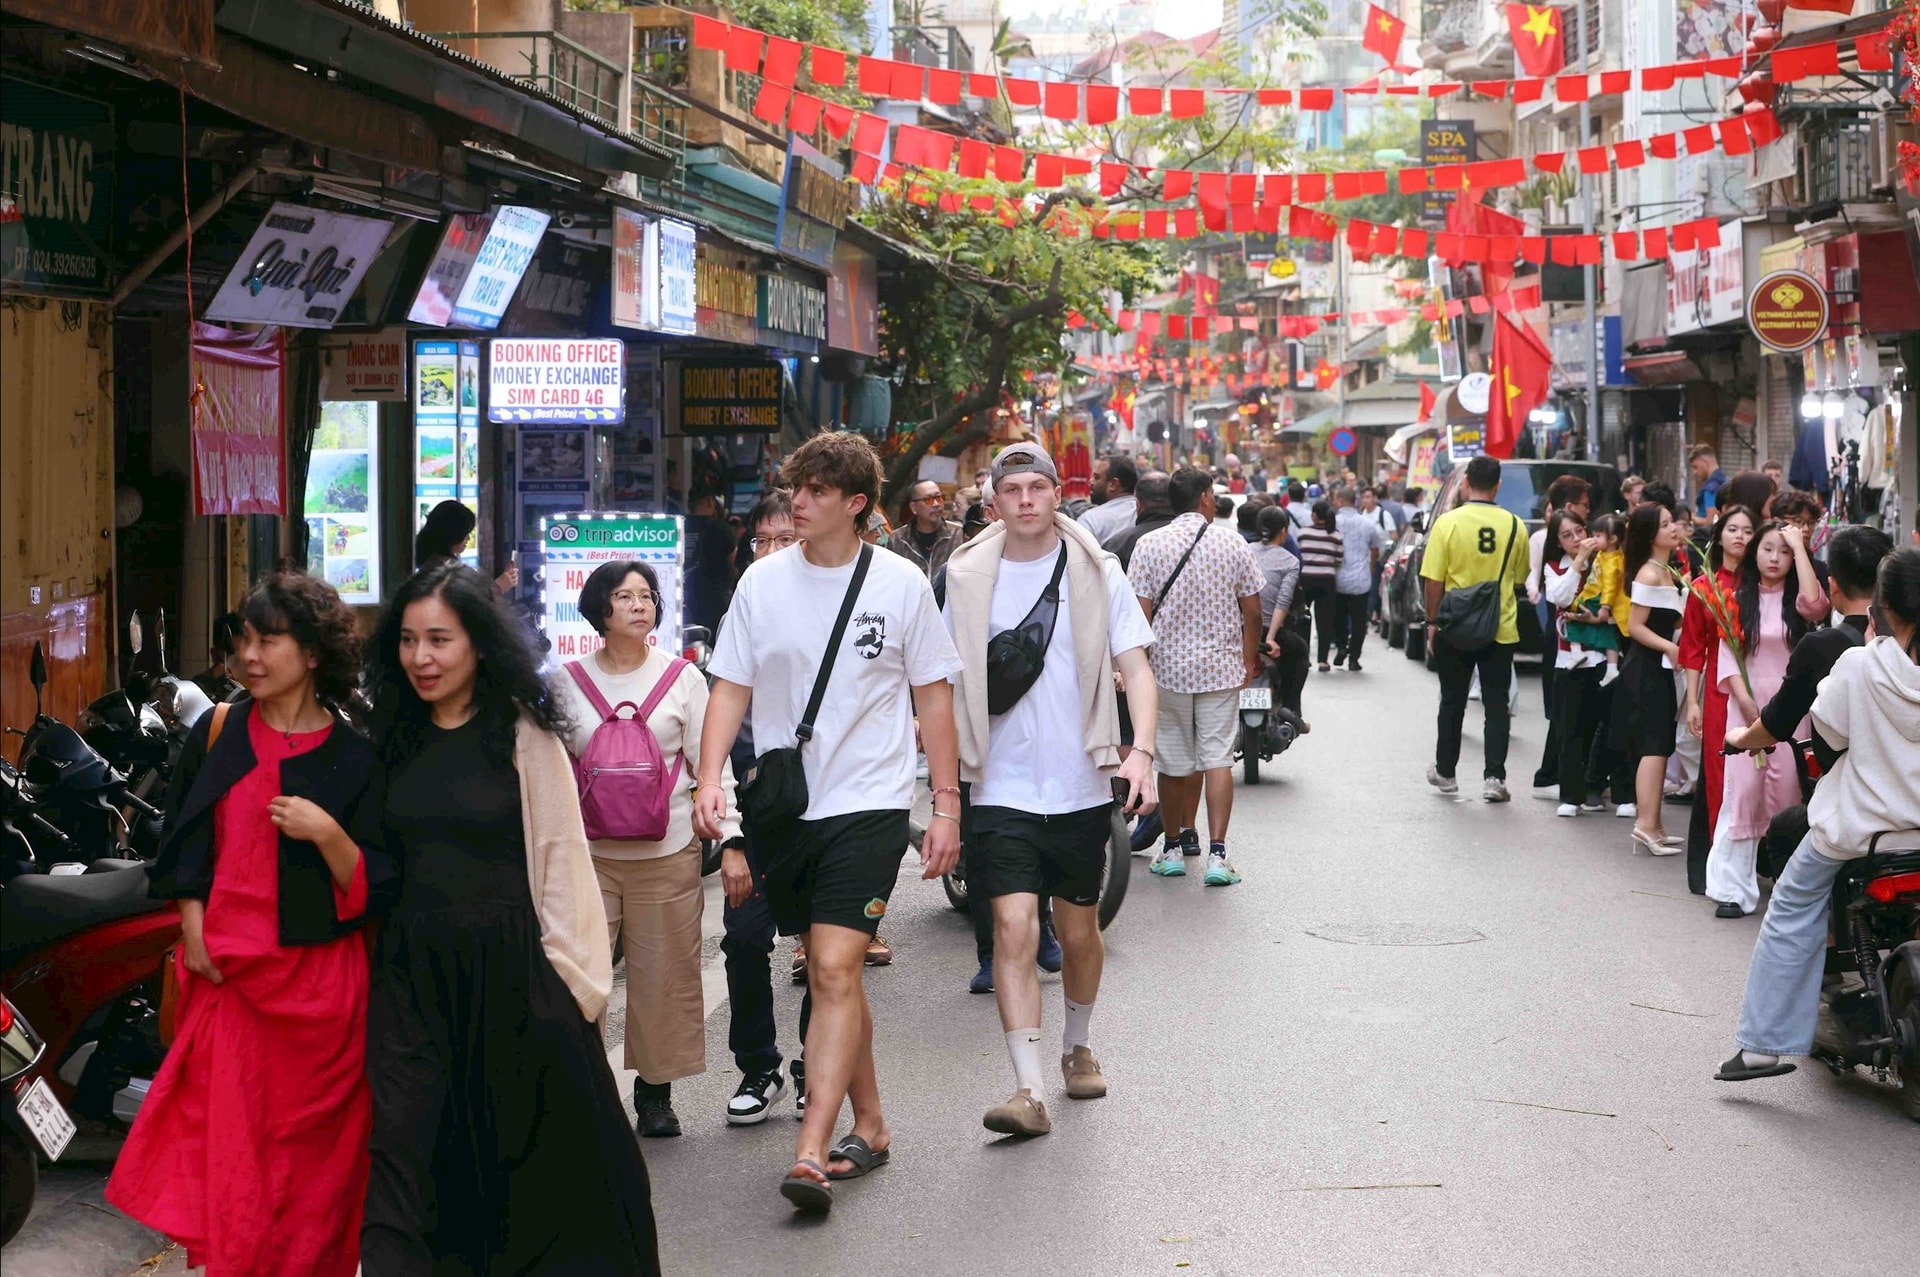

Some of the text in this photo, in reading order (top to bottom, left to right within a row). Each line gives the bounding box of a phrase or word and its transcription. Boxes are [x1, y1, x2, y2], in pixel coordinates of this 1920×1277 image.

[1428, 131, 1467, 147] SPA
[0, 121, 94, 225] TRANG
[767, 274, 801, 334] BOOKING
[801, 285, 826, 340] OFFICE
[379, 344, 399, 367] CAM
[495, 343, 561, 362] BOOKING
[567, 344, 617, 363] OFFICE
[493, 366, 618, 385] MONEY EXCHANGE
[684, 367, 777, 399] BOOKING OFFICE
[507, 388, 603, 405] SIM CARD 4G
[533, 408, 577, 419] (Best Price)
[684, 406, 778, 425] MONEY EXCHANGE
[585, 525, 676, 545] tripadvisor
[1478, 527, 1496, 554] 8
[586, 551, 635, 561] (Best Price)
[566, 570, 583, 590] HA
[558, 635, 575, 655] HA
